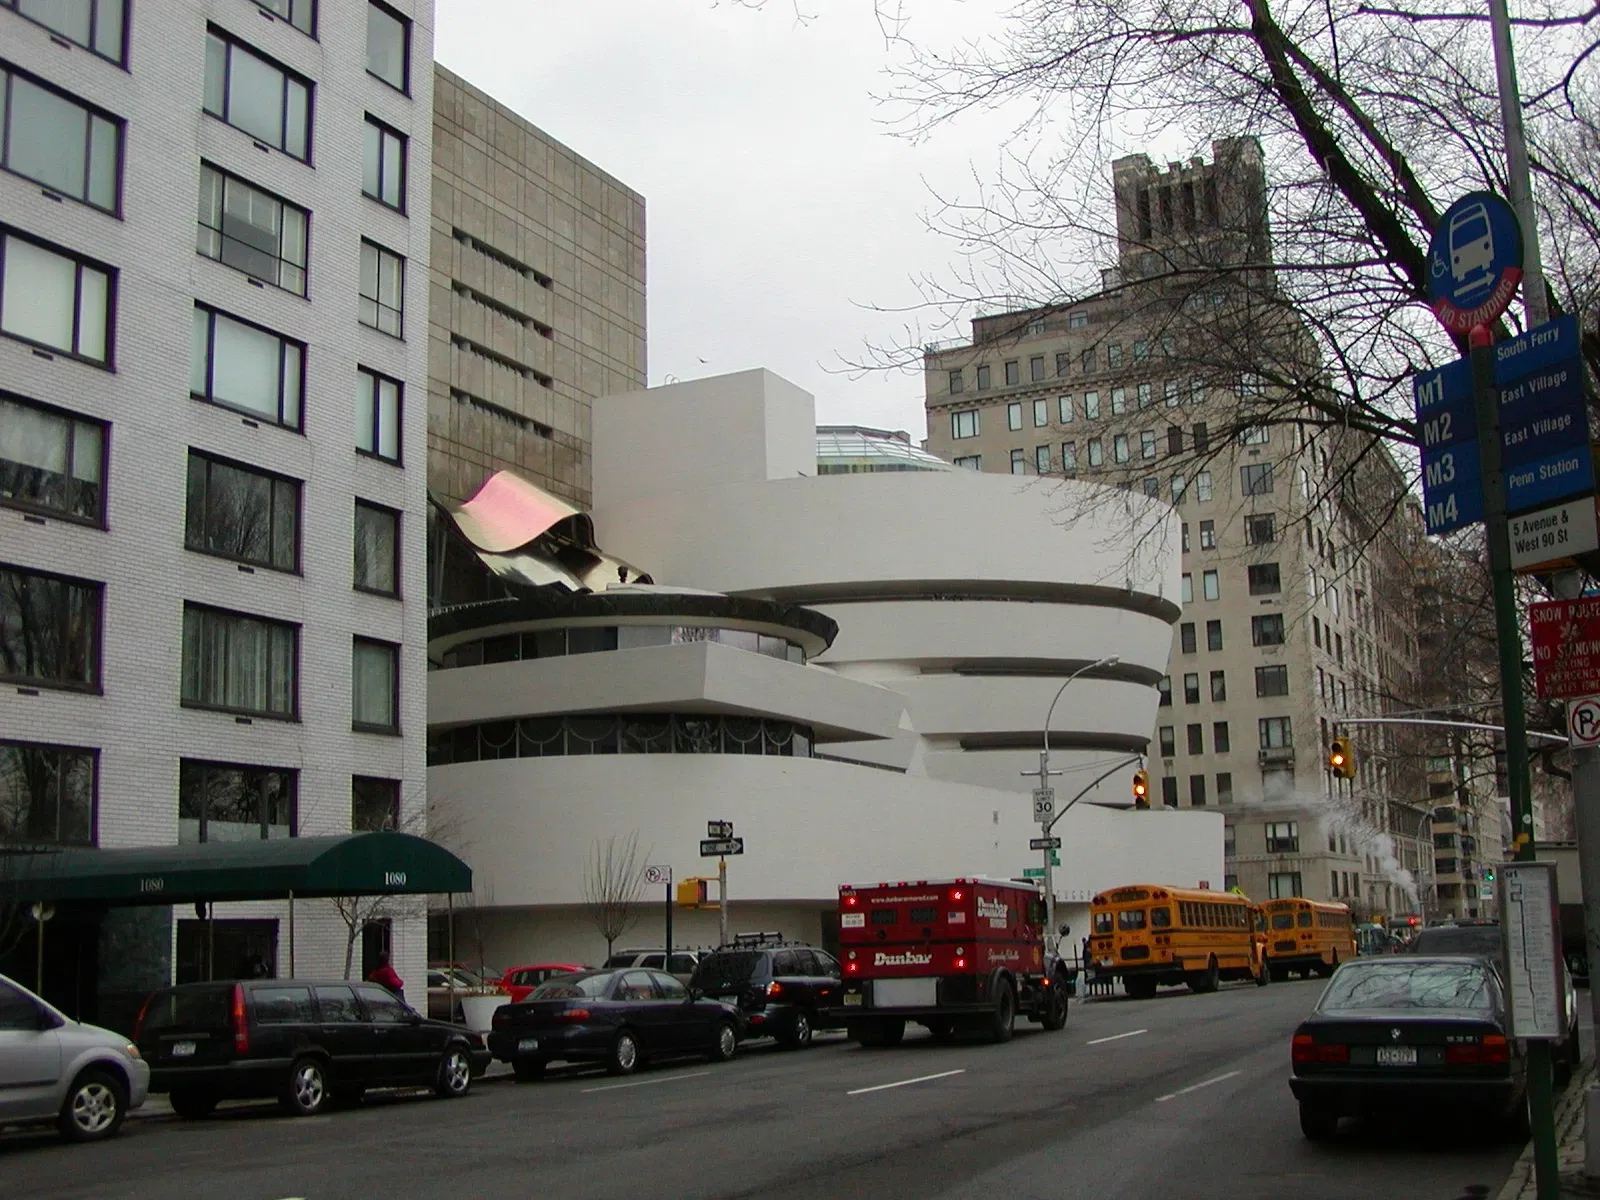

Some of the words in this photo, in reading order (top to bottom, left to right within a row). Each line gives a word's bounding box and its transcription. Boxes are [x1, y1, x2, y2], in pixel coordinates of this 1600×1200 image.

[1439, 304, 1455, 324] NO
[1458, 279, 1513, 328] STANDING
[1497, 338, 1527, 360] South
[1531, 327, 1559, 347] Ferry
[1417, 373, 1444, 408] M1
[1501, 384, 1525, 404] East
[1528, 371, 1568, 394] Village
[1424, 412, 1453, 447] M2
[1504, 427, 1528, 446] East
[1532, 413, 1571, 437] Village
[1426, 453, 1455, 488] M3
[1509, 474, 1535, 489] Penn
[1539, 458, 1579, 480] Station
[1428, 493, 1459, 529] M4
[1513, 522, 1520, 536] 5
[1523, 515, 1558, 534] Avenue
[1561, 509, 1569, 523] &
[1515, 536, 1539, 554] West
[1542, 532, 1555, 547] 90
[1557, 529, 1569, 543] St
[1533, 606, 1562, 624] SNOW
[1536, 645, 1551, 660] NO
[1036, 802, 1052, 813] 30
[140, 878, 164, 893] 1080
[384, 872, 406, 886] 1080
[977, 896, 1008, 918] Dunbar
[874, 951, 932, 966] Dunbar
